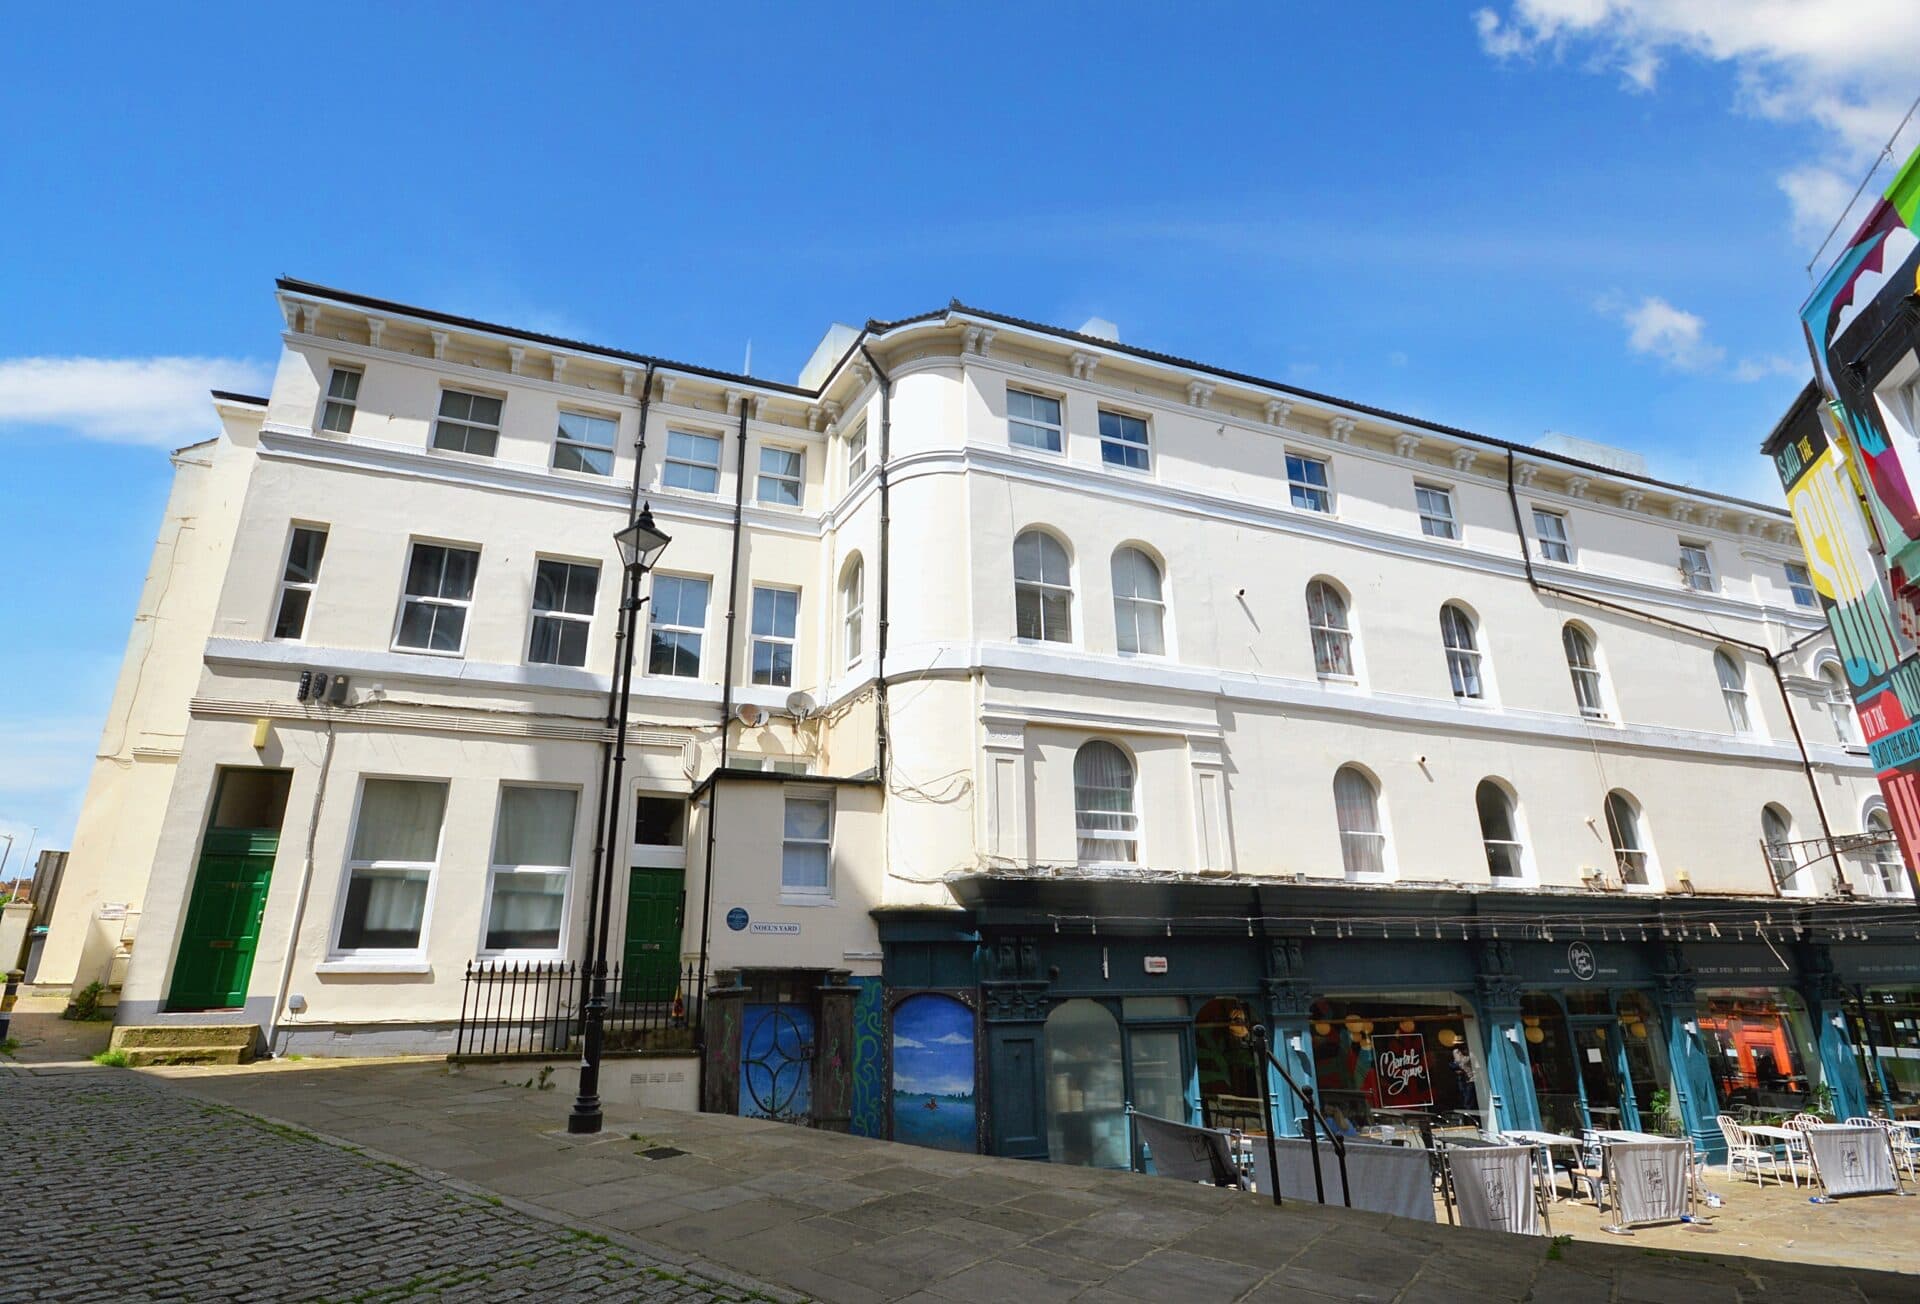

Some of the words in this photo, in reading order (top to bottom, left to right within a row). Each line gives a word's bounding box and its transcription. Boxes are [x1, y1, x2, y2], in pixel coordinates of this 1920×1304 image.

[1777, 442, 1801, 485] SAID
[1797, 435, 1814, 463] THE
[1861, 711, 1876, 737] TO
[1871, 705, 1889, 733] THE
